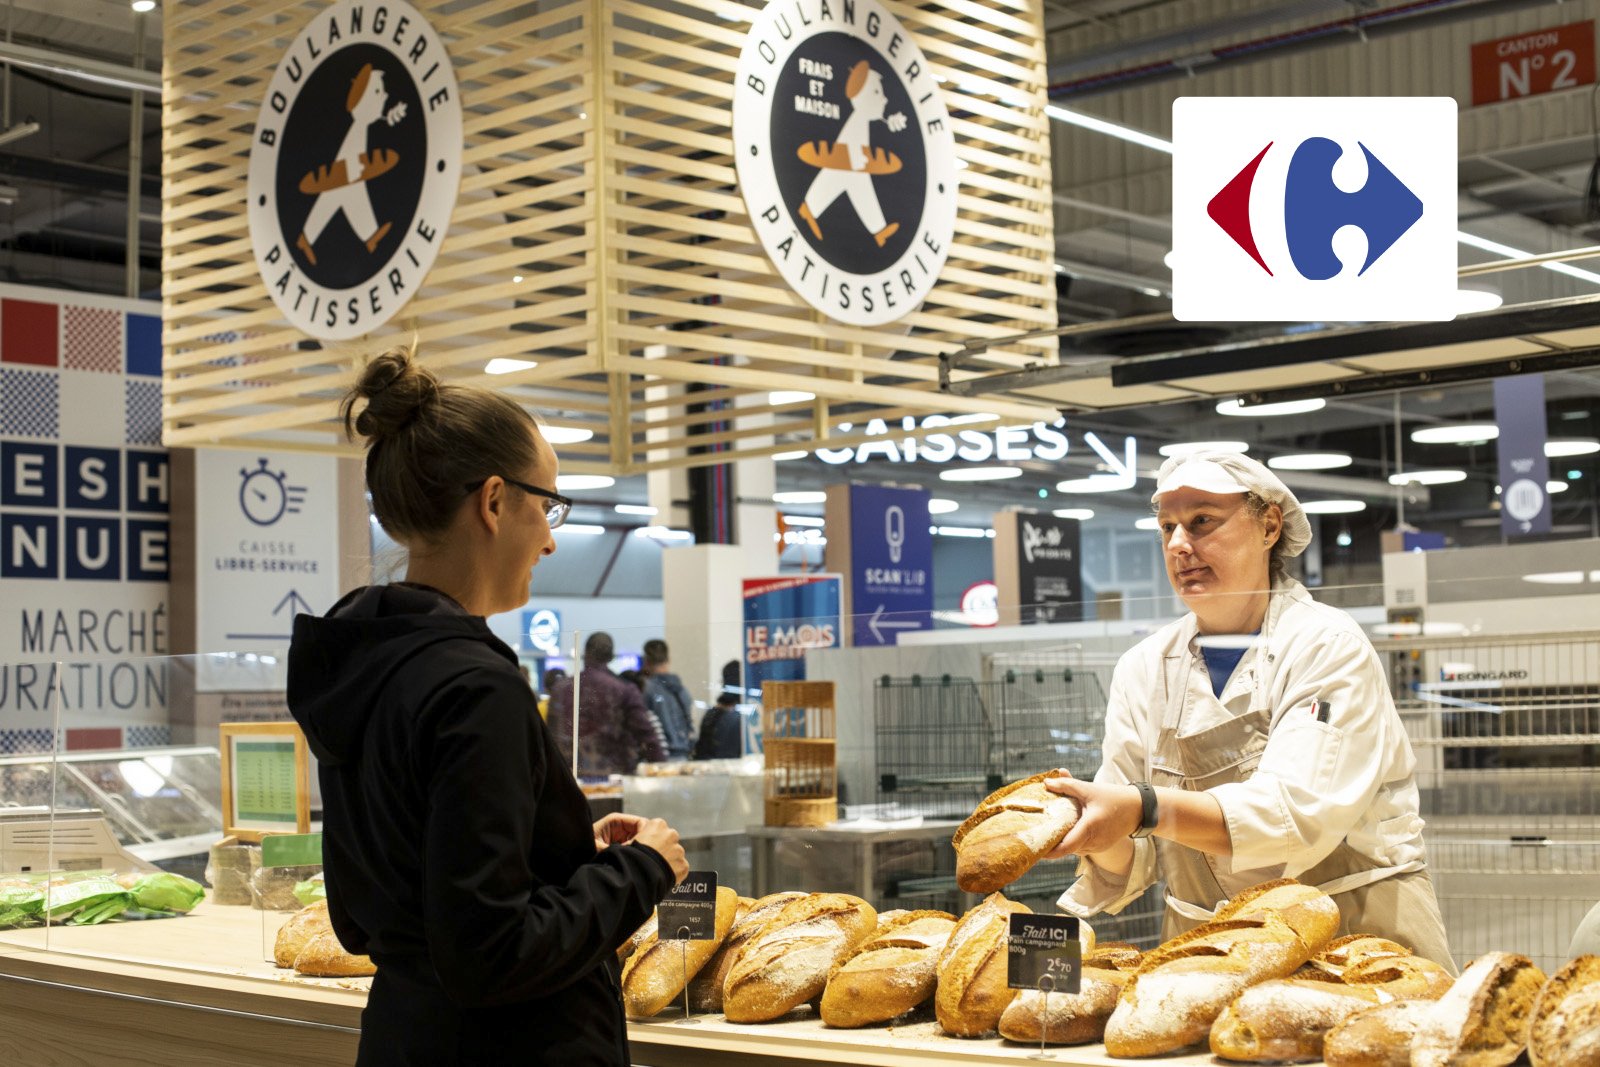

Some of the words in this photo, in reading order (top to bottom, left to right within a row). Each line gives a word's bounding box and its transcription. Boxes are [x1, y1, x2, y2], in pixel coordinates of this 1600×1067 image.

[1496, 31, 1559, 57] CANTON
[259, 6, 450, 148] BOULANGERIE
[747, 0, 945, 136] BOULANGERIE
[799, 57, 834, 81] FRAIS
[1550, 48, 1578, 92] 2
[809, 79, 825, 97] ET
[794, 95, 840, 120] MAISON
[761, 204, 942, 314] PÂTISSERIE
[264, 218, 437, 328] PÂTISSERIE
[238, 541, 296, 556] CAISSE
[215, 557, 319, 574] LIBRE-SERVICE
[21, 602, 167, 654] MARCHÉ
[747, 626, 768, 649] LE
[772, 623, 836, 648] MOIS
[671, 883, 691, 894] Fait
[693, 883, 707, 893] ICI
[1008, 936, 1024, 945] Pain
[1025, 939, 1066, 949] campagnard
[1022, 925, 1047, 938] Fait
[1050, 928, 1067, 940] ICI
[1009, 945, 1026, 956] 800g
